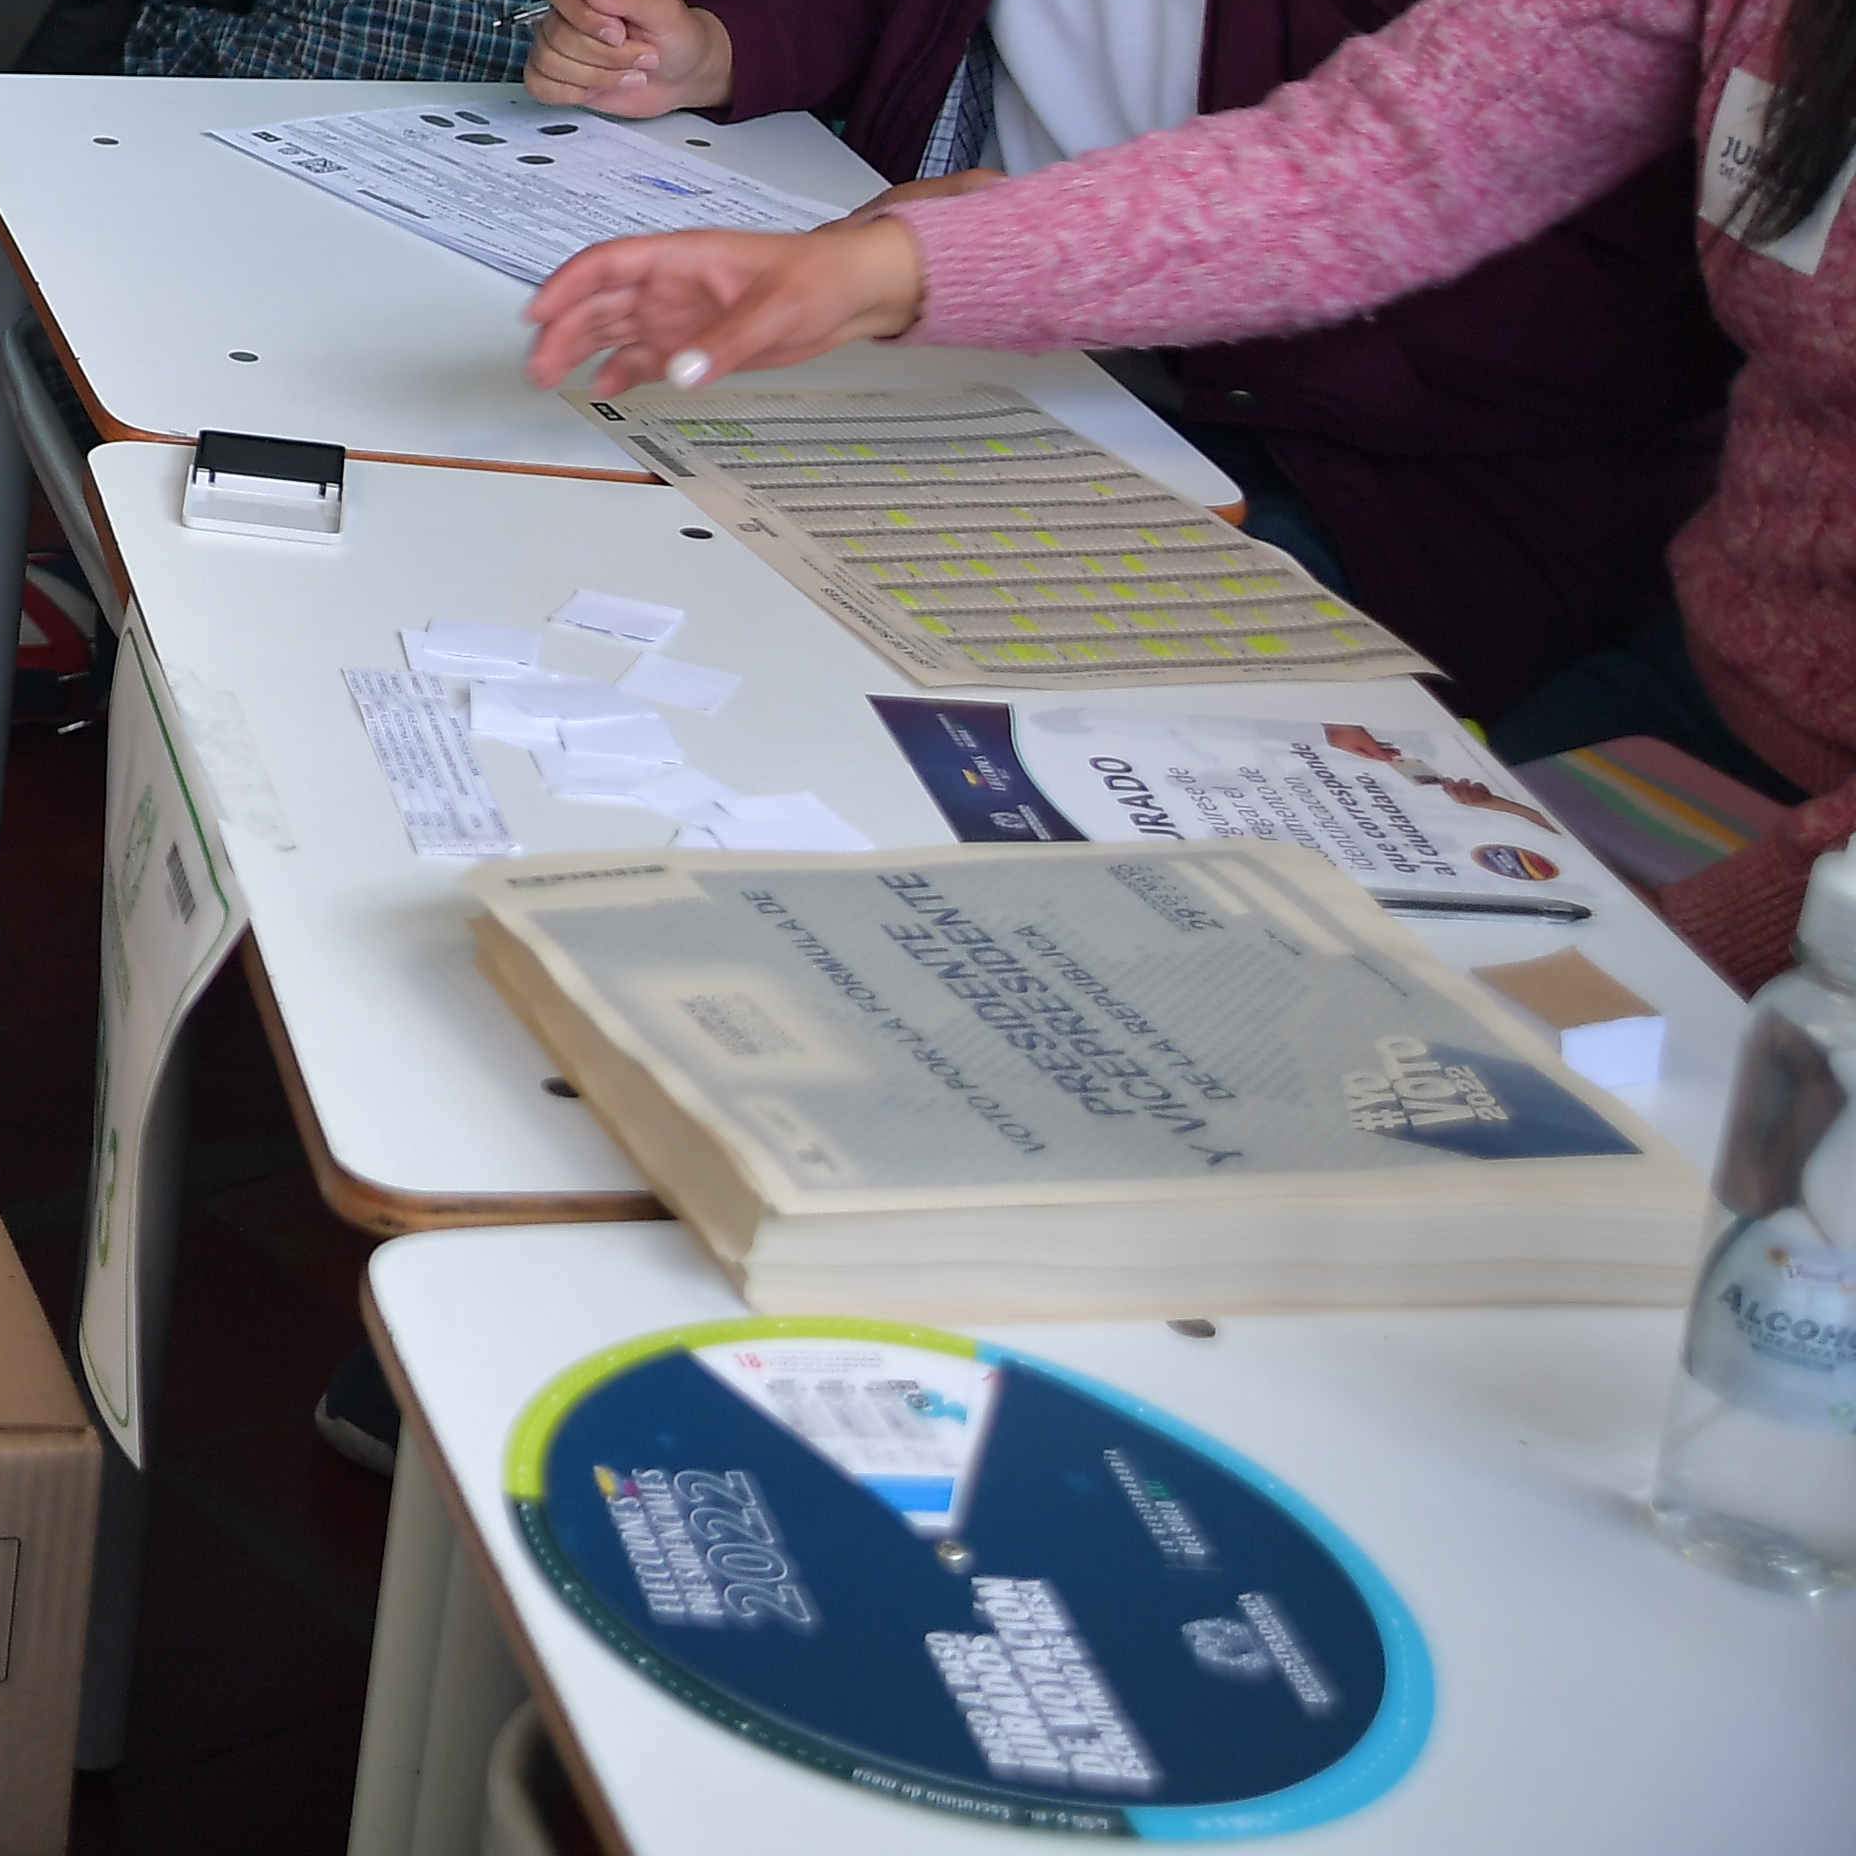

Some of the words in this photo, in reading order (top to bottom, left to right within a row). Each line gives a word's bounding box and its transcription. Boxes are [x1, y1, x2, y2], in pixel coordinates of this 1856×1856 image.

[1166, 766, 1196, 784] de
[1212, 786, 1245, 800] el
[1238, 765, 1266, 784] de
[1290, 742, 1387, 839] corresponde
[1256, 785, 1337, 867] cumento
[1284, 776, 1377, 871] identificación
[1355, 771, 1440, 857] ciudadano.
[1376, 842, 1421, 874] que
[1420, 859, 1457, 877] al
[741, 890, 787, 914] DE
[1175, 908, 1225, 930] 29
[876, 872, 1208, 1135] VICEPRESIDENTE
[880, 923, 1136, 1116] PRESIDENTE
[880, 1017, 924, 1042] LA
[912, 1048, 979, 1090] POR
[1149, 1039, 1195, 1068] LA
[1182, 1072, 1237, 1101] DE
[1343, 1072, 1408, 1132] #YO
[1376, 1036, 1474, 1127] VOTO
[1445, 1065, 1509, 1121] 2022
[968, 1095, 1046, 1154] VOTO
[1189, 1143, 1243, 1167] Y
[607, 1496, 686, 1612] ELECCIONES
[673, 1470, 811, 1623] 2022
[1014, 1580, 1066, 1632] MESA
[924, 1631, 978, 1686] PASO
[971, 1576, 1091, 1726] VOTACIÓN
[1045, 1636, 1083, 1661] DE
[966, 1634, 1070, 1773] JURADOS
[1062, 1663, 1151, 1780] ESCRUTINIO
[966, 1709, 1022, 1766] PASO
[1057, 1734, 1121, 1777] DE
[852, 1768, 896, 1789] mesa
[901, 1783, 922, 1798] de
